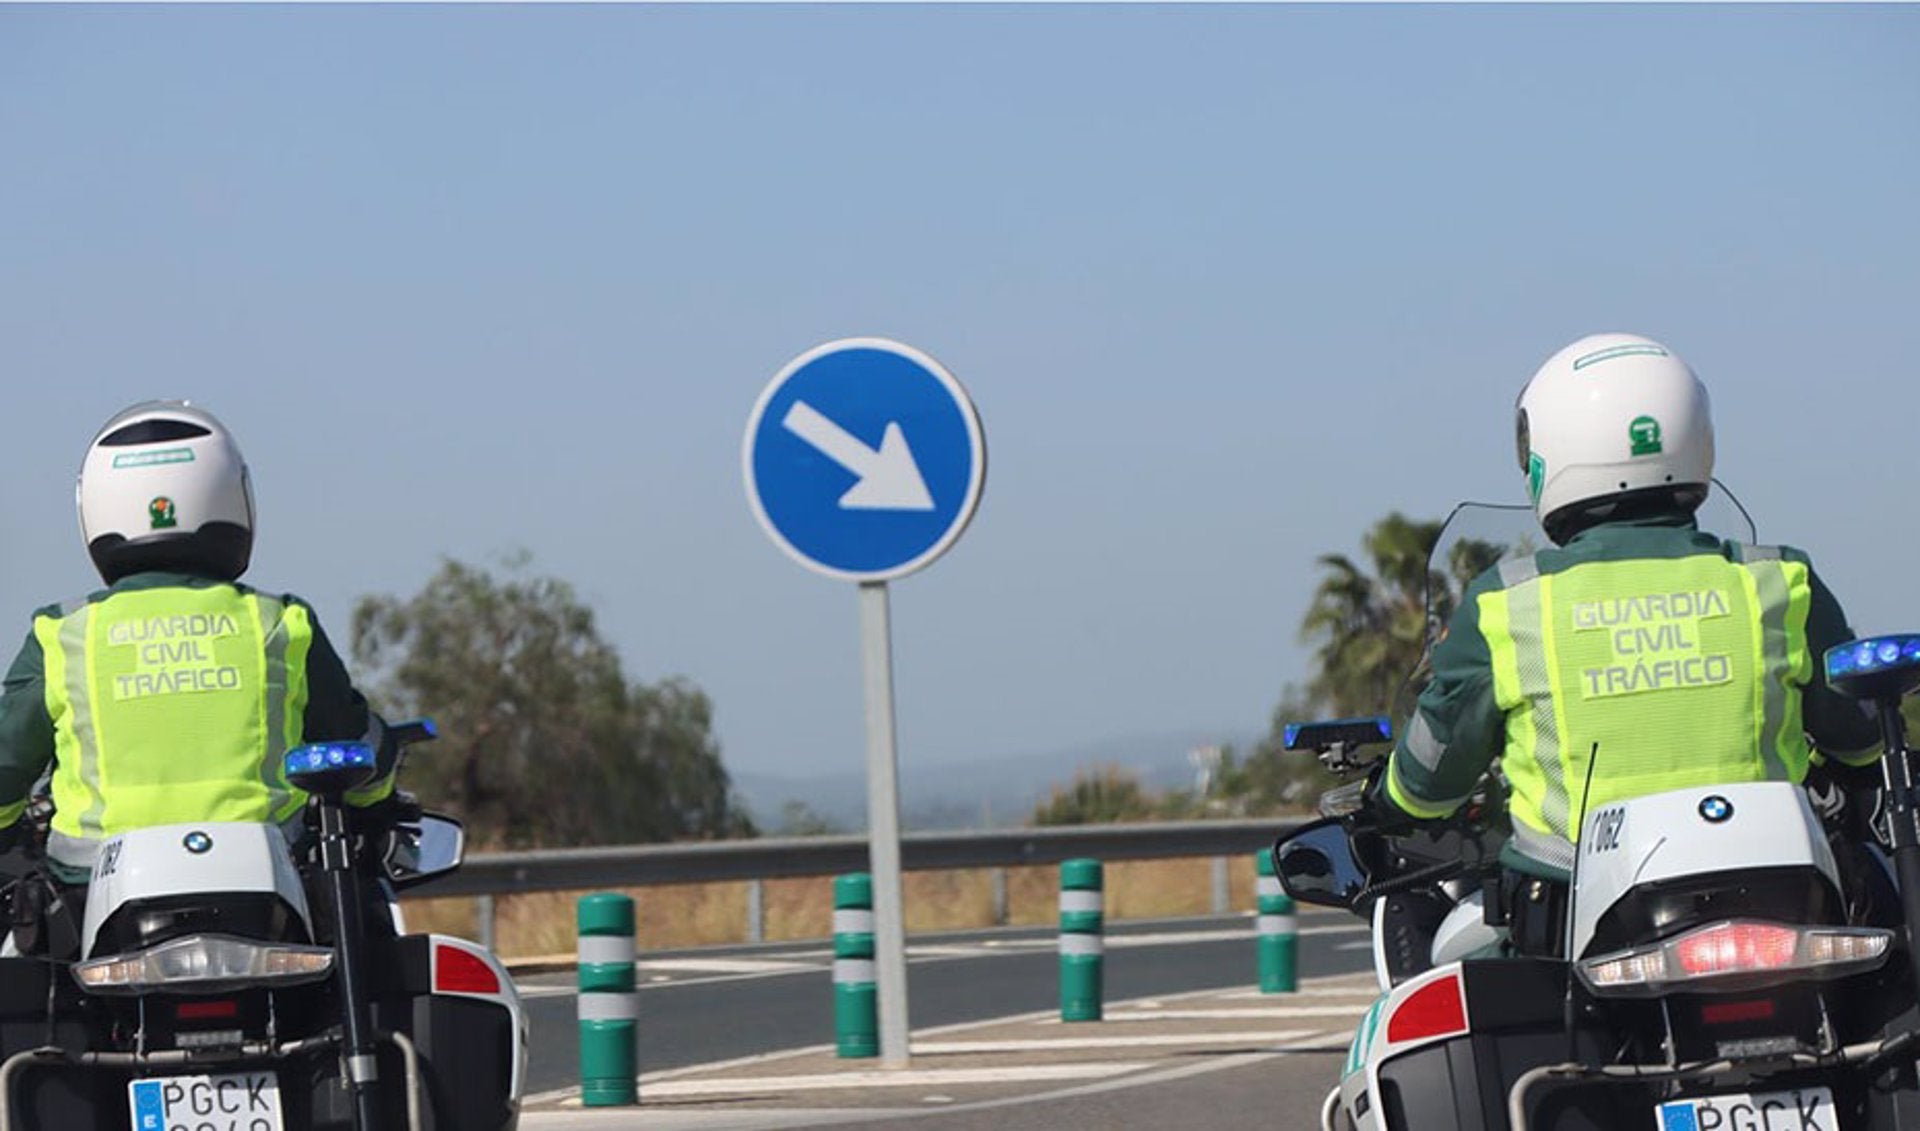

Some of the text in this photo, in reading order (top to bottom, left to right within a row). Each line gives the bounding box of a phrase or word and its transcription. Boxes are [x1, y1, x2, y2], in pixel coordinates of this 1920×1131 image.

[1575, 589, 1726, 627] GUARDIA
[109, 613, 236, 643] GUARDIA
[1615, 624, 1693, 655] CIVIL
[141, 640, 208, 664] CIVIL
[115, 666, 238, 697] TRÁFICO
[1584, 655, 1728, 694] TRÁFICO
[163, 1076, 270, 1119] PGCK
[1696, 1095, 1820, 1131] PGCK
[143, 1114, 157, 1129] E
